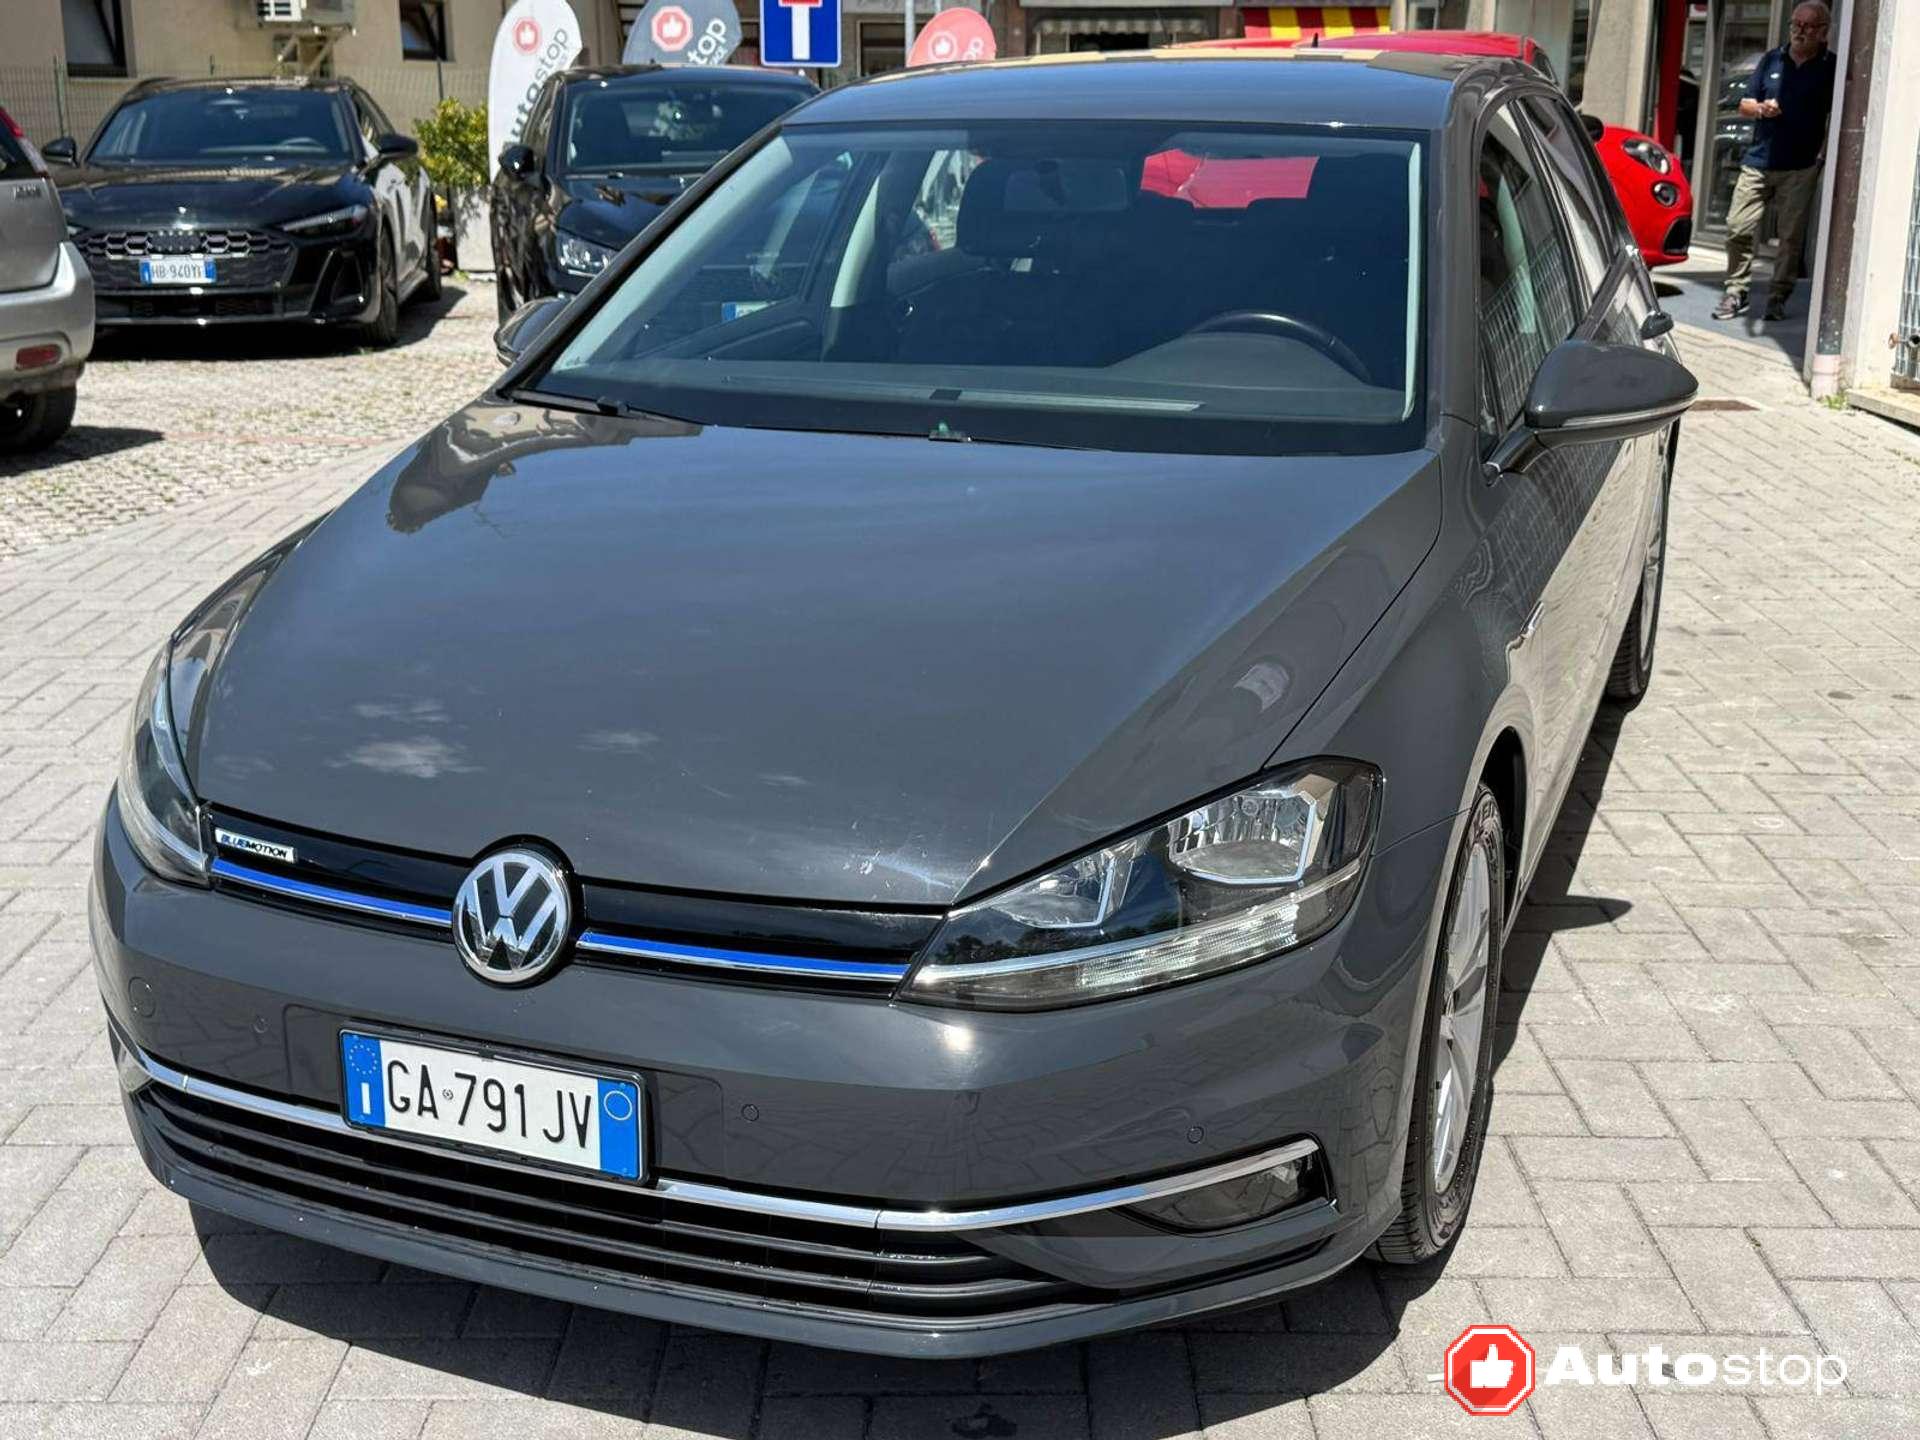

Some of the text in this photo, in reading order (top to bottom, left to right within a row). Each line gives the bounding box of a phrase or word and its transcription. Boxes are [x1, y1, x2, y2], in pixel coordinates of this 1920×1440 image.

[510, 28, 568, 137] utostop
[687, 17, 726, 64] top
[386, 1059, 592, 1149] GA 791 JV
